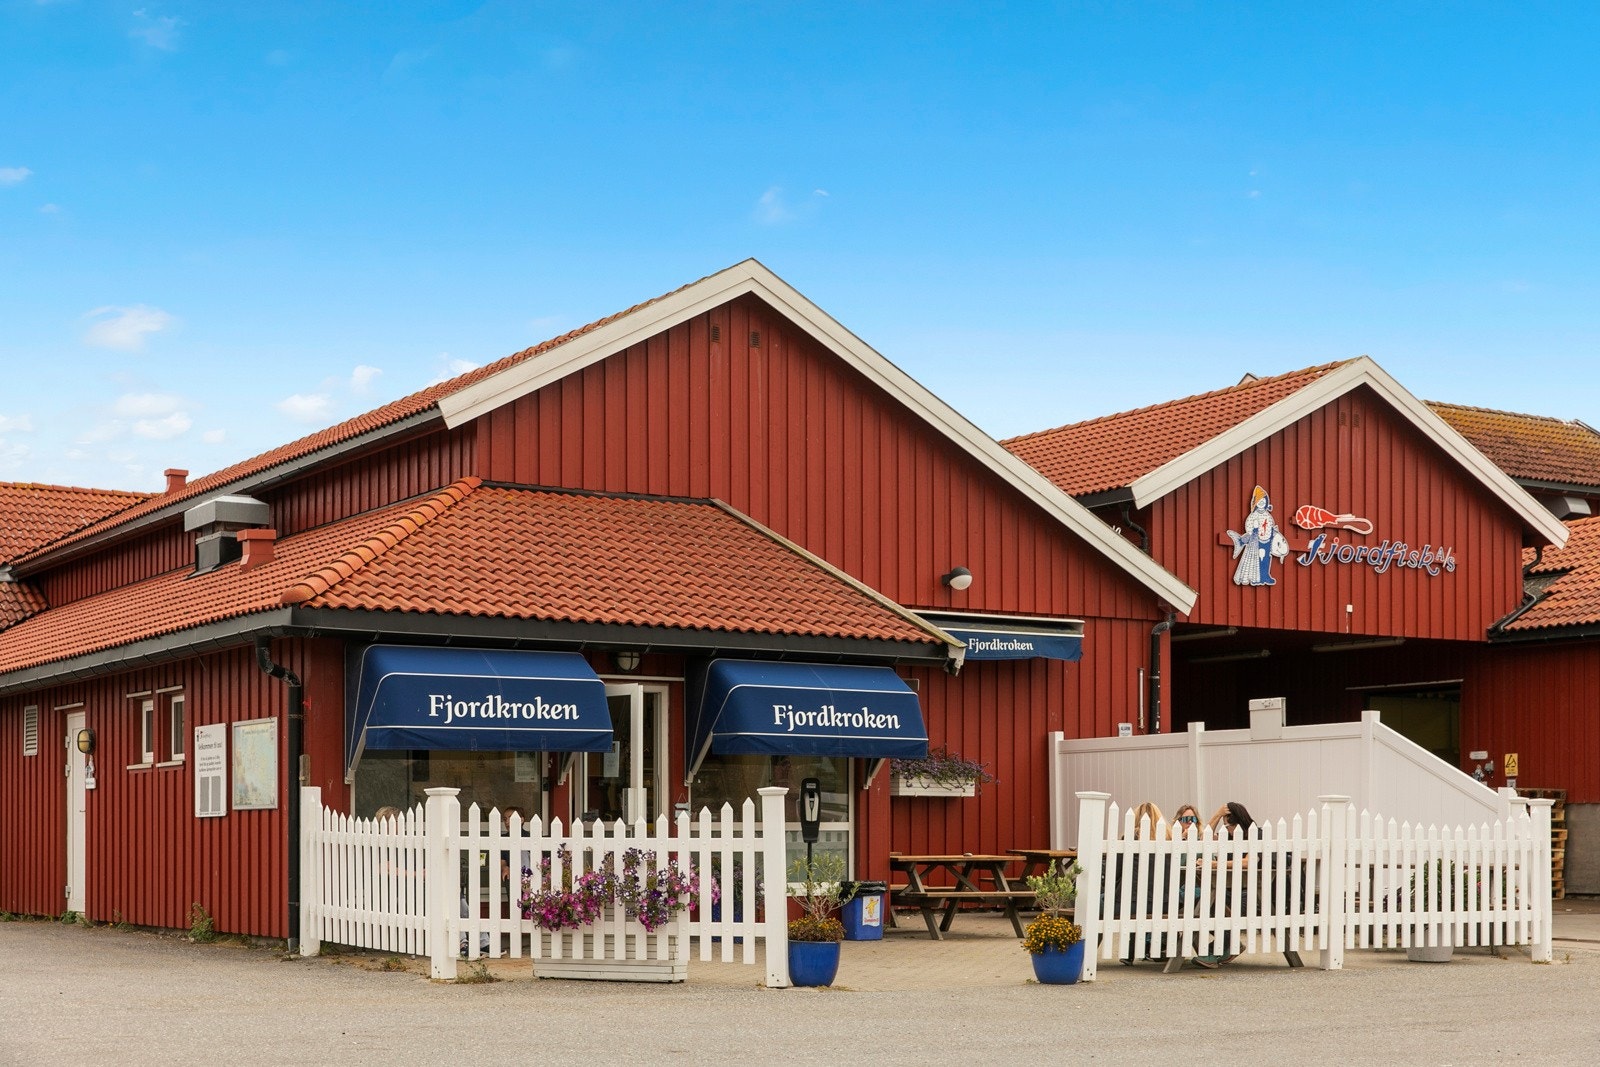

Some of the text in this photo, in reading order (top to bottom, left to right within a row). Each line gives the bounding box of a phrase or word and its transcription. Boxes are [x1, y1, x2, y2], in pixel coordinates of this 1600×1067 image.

[968, 637, 1034, 654] Fjordkroken
[428, 694, 580, 724] Fjordkroken
[772, 704, 901, 732] Fjordkroken
